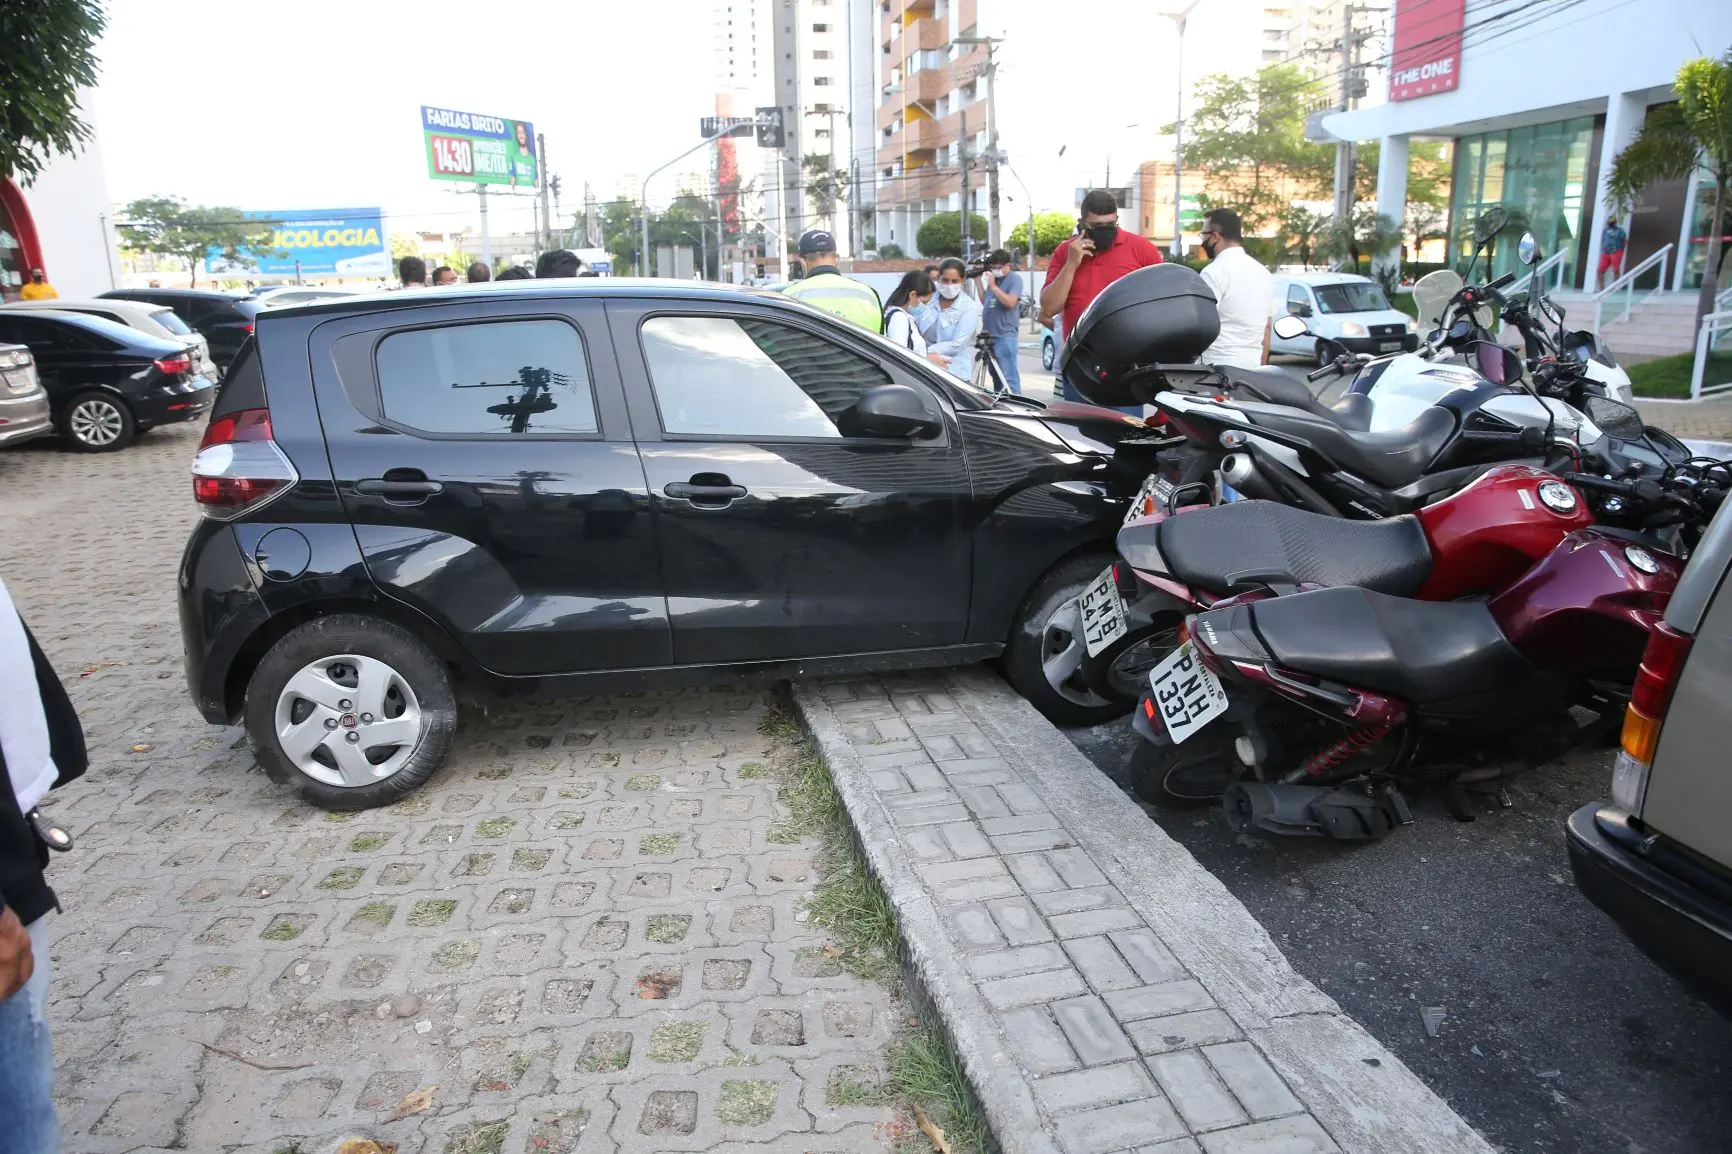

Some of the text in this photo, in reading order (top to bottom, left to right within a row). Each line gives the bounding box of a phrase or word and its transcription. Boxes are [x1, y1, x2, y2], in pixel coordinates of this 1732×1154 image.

[1394, 58, 1454, 87] THE ONE
[426, 108, 505, 135] FARIAS BRITO
[1081, 592, 1104, 645] 5417
[1093, 580, 1119, 636] PMB
[1203, 620, 1218, 645] YAMAHA
[1154, 669, 1192, 729] 1337
[1172, 654, 1210, 719] PNH
